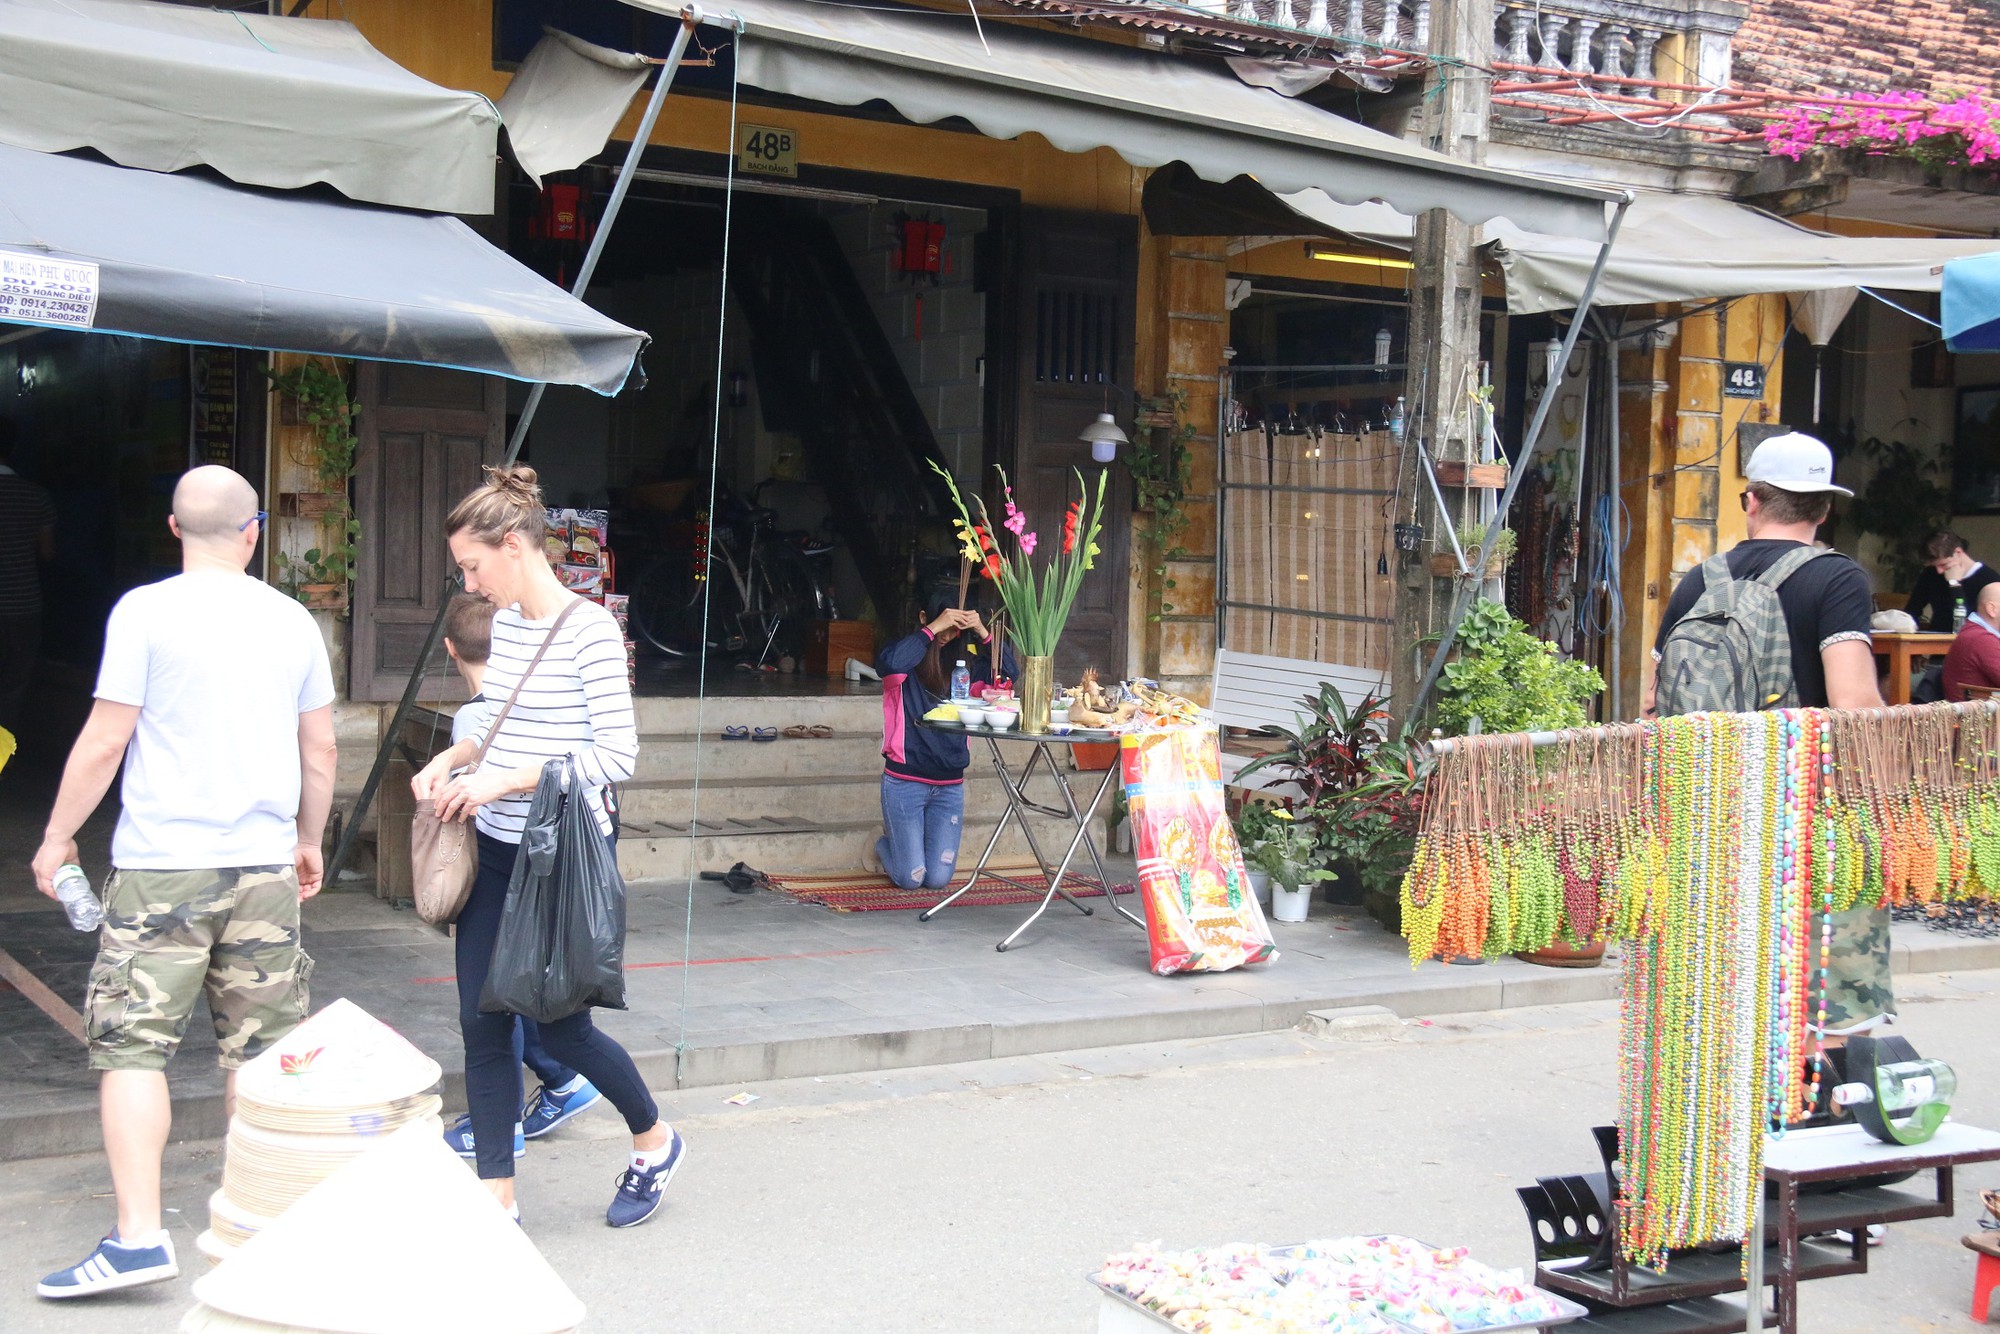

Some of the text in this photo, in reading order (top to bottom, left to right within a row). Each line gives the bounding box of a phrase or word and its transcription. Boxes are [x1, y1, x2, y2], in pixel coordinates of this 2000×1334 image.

[2, 284, 30, 294] 255
[43, 282, 91, 293] 203
[20, 297, 90, 314] 0914.230428
[18, 308, 87, 323] 0511.3600285
